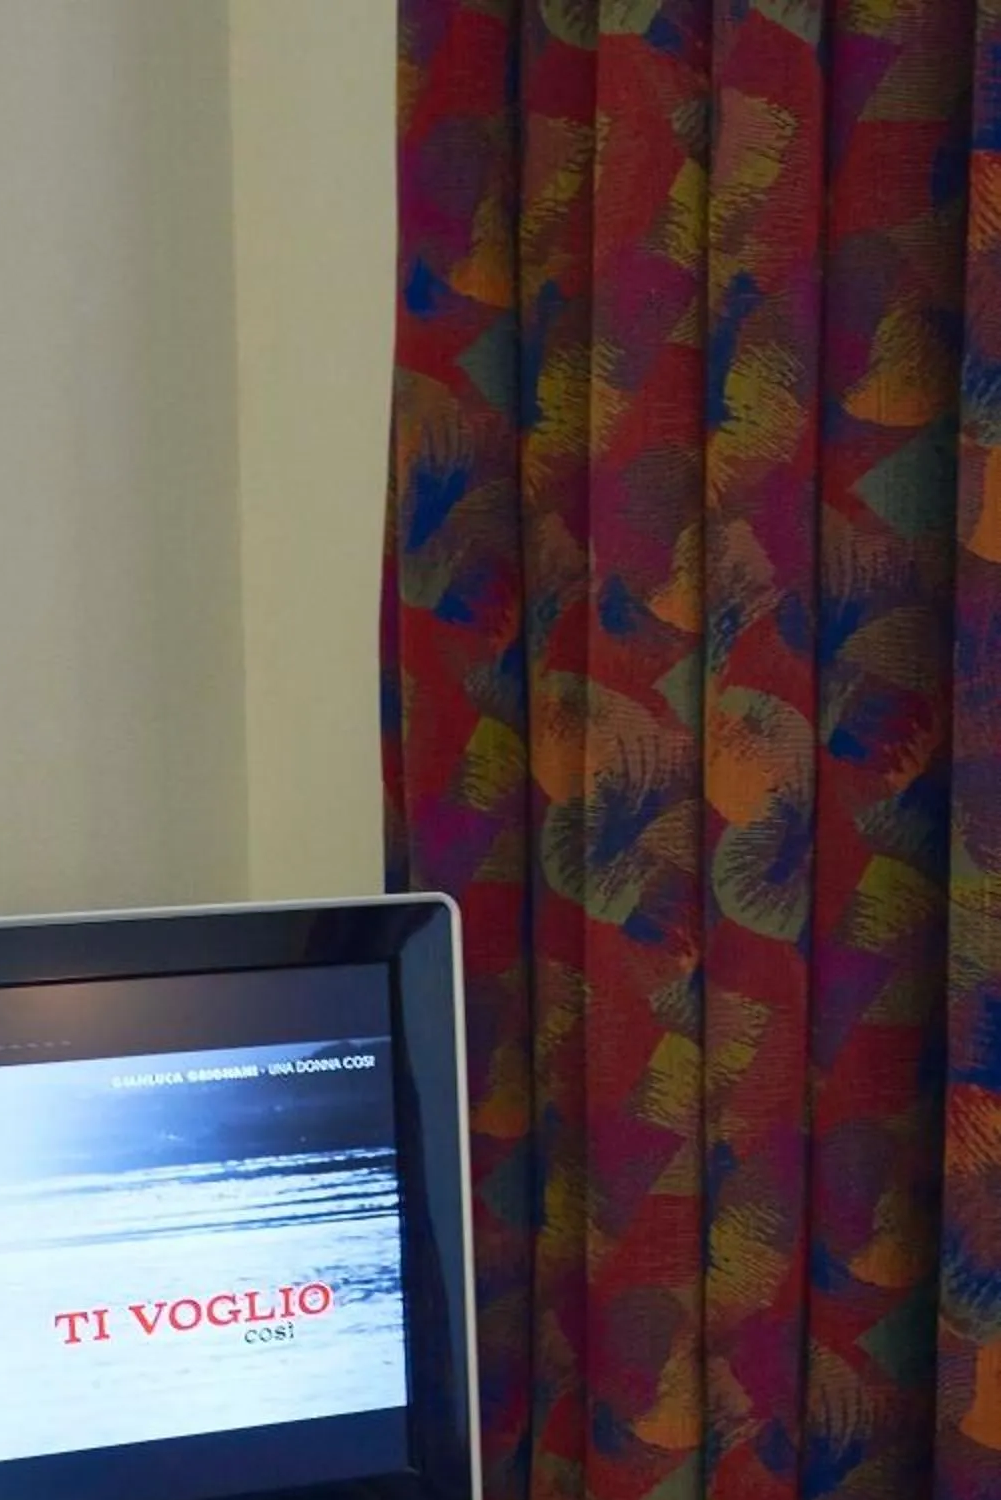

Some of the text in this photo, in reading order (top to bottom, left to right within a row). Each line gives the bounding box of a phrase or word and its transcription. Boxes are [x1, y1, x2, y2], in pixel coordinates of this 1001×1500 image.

[268, 1062, 295, 1075] UNA
[295, 1057, 342, 1073] DONNA
[54, 1282, 333, 1345] TI VOGLIO
